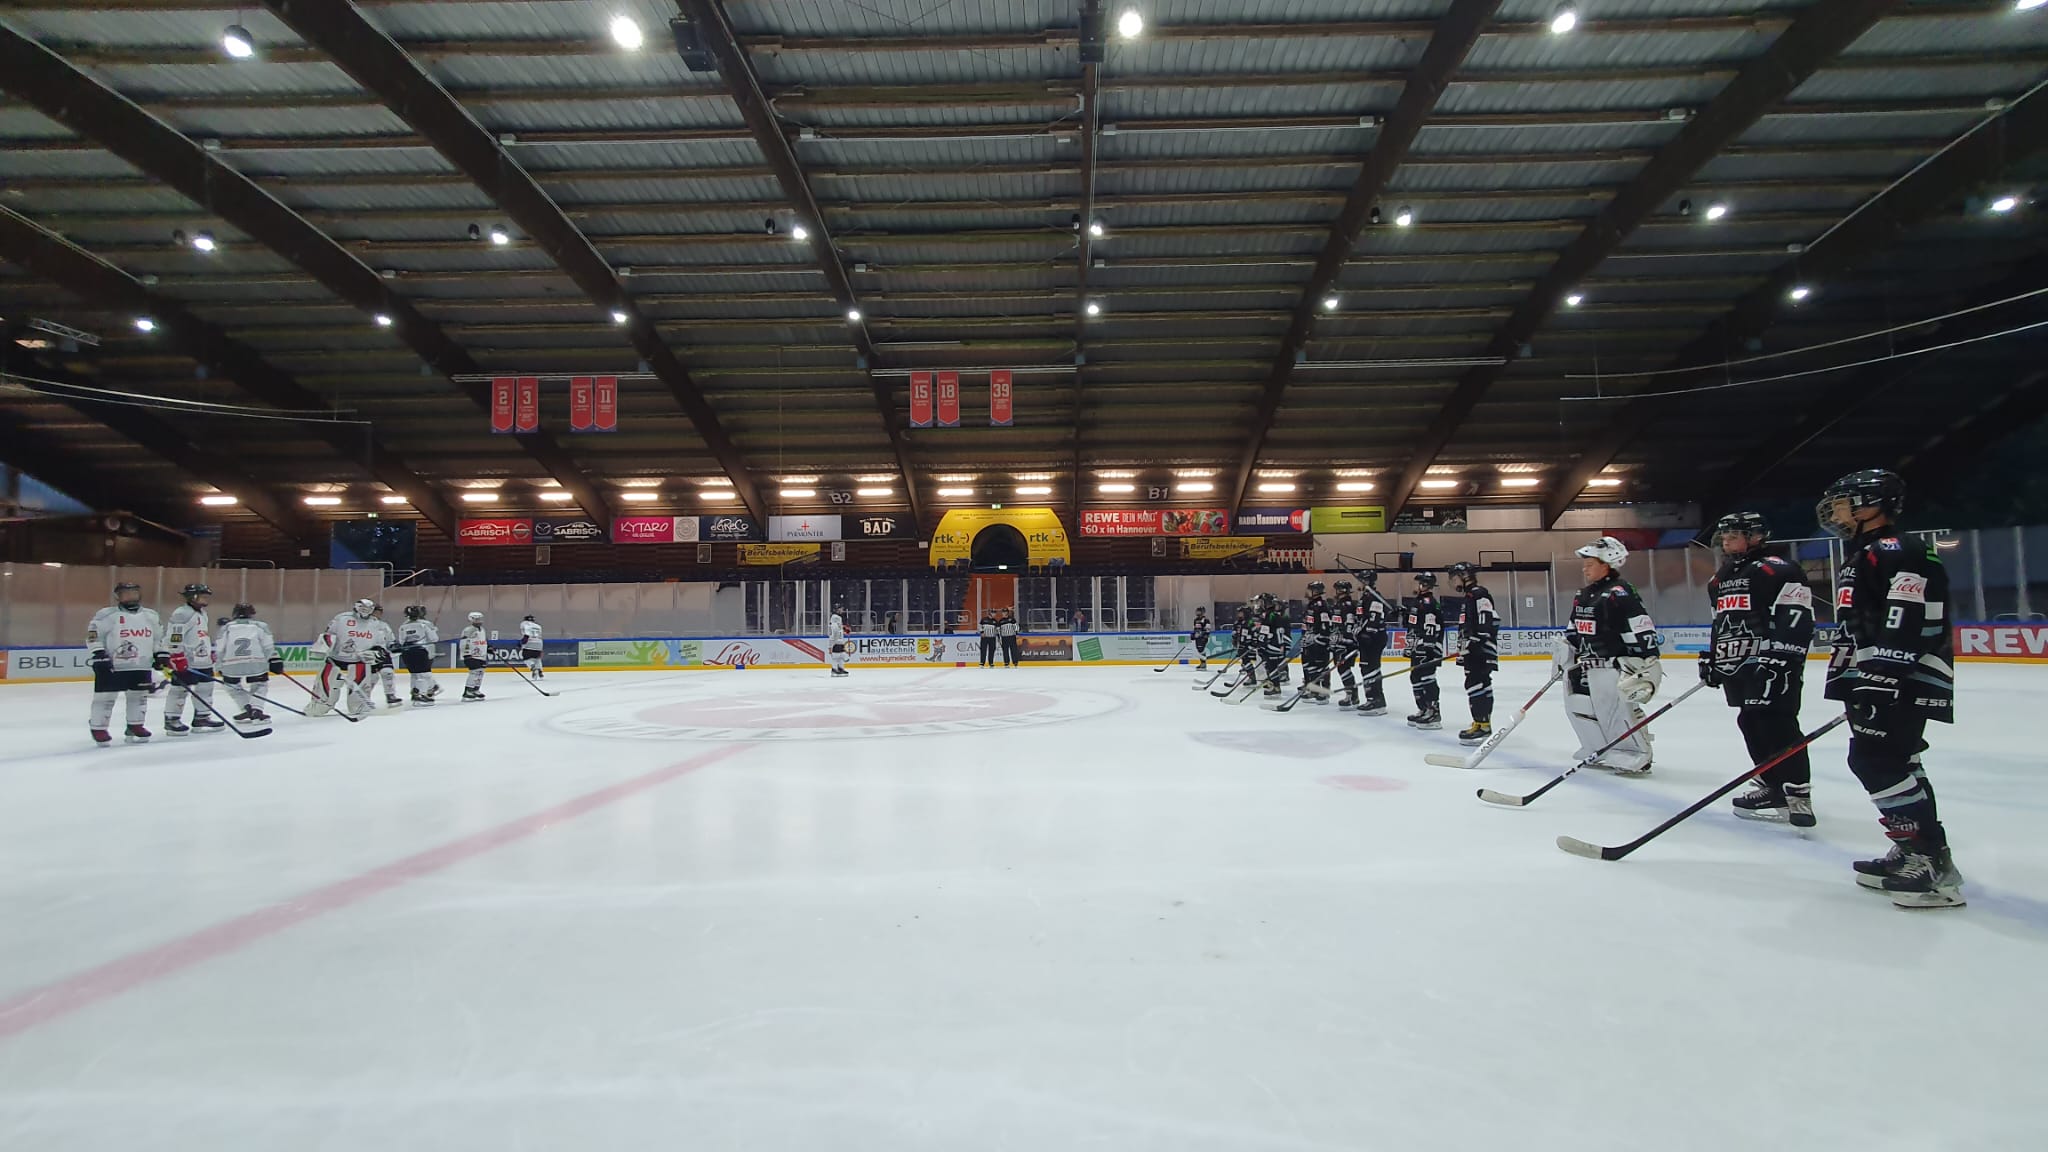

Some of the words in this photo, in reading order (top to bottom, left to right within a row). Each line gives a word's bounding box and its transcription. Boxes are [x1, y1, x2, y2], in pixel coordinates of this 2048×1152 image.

[523, 390, 531, 404] 3
[577, 390, 586, 404] 5
[601, 390, 610, 403] 11
[914, 384, 928, 399] 15
[941, 384, 955, 398] 18
[993, 383, 1009, 398] 39
[499, 391, 508, 404] 2
[830, 492, 853, 504] B2
[1149, 487, 1168, 499] B1
[1085, 512, 1120, 523] REWE
[1256, 514, 1288, 525] Hannover
[460, 528, 508, 536] GABRISCH
[554, 527, 601, 536] GABRISCH
[620, 521, 669, 532] KYTARO
[863, 522, 891, 533] BAD
[1085, 525, 1097, 534] 60
[1106, 525, 1115, 533] in
[1117, 525, 1157, 534] Hannover
[934, 533, 954, 543] rtk
[1029, 532, 1049, 542] rtk
[1789, 609, 1802, 628] 7
[1886, 607, 1904, 629] 9
[347, 630, 373, 639] swb
[1426, 626, 1434, 636] 21
[234, 638, 251, 656] 2
[860, 639, 915, 653] HEYMEIER
[1716, 637, 1762, 659] SGH
[703, 641, 760, 665] Liebe
[19, 656, 64, 669] BBL
